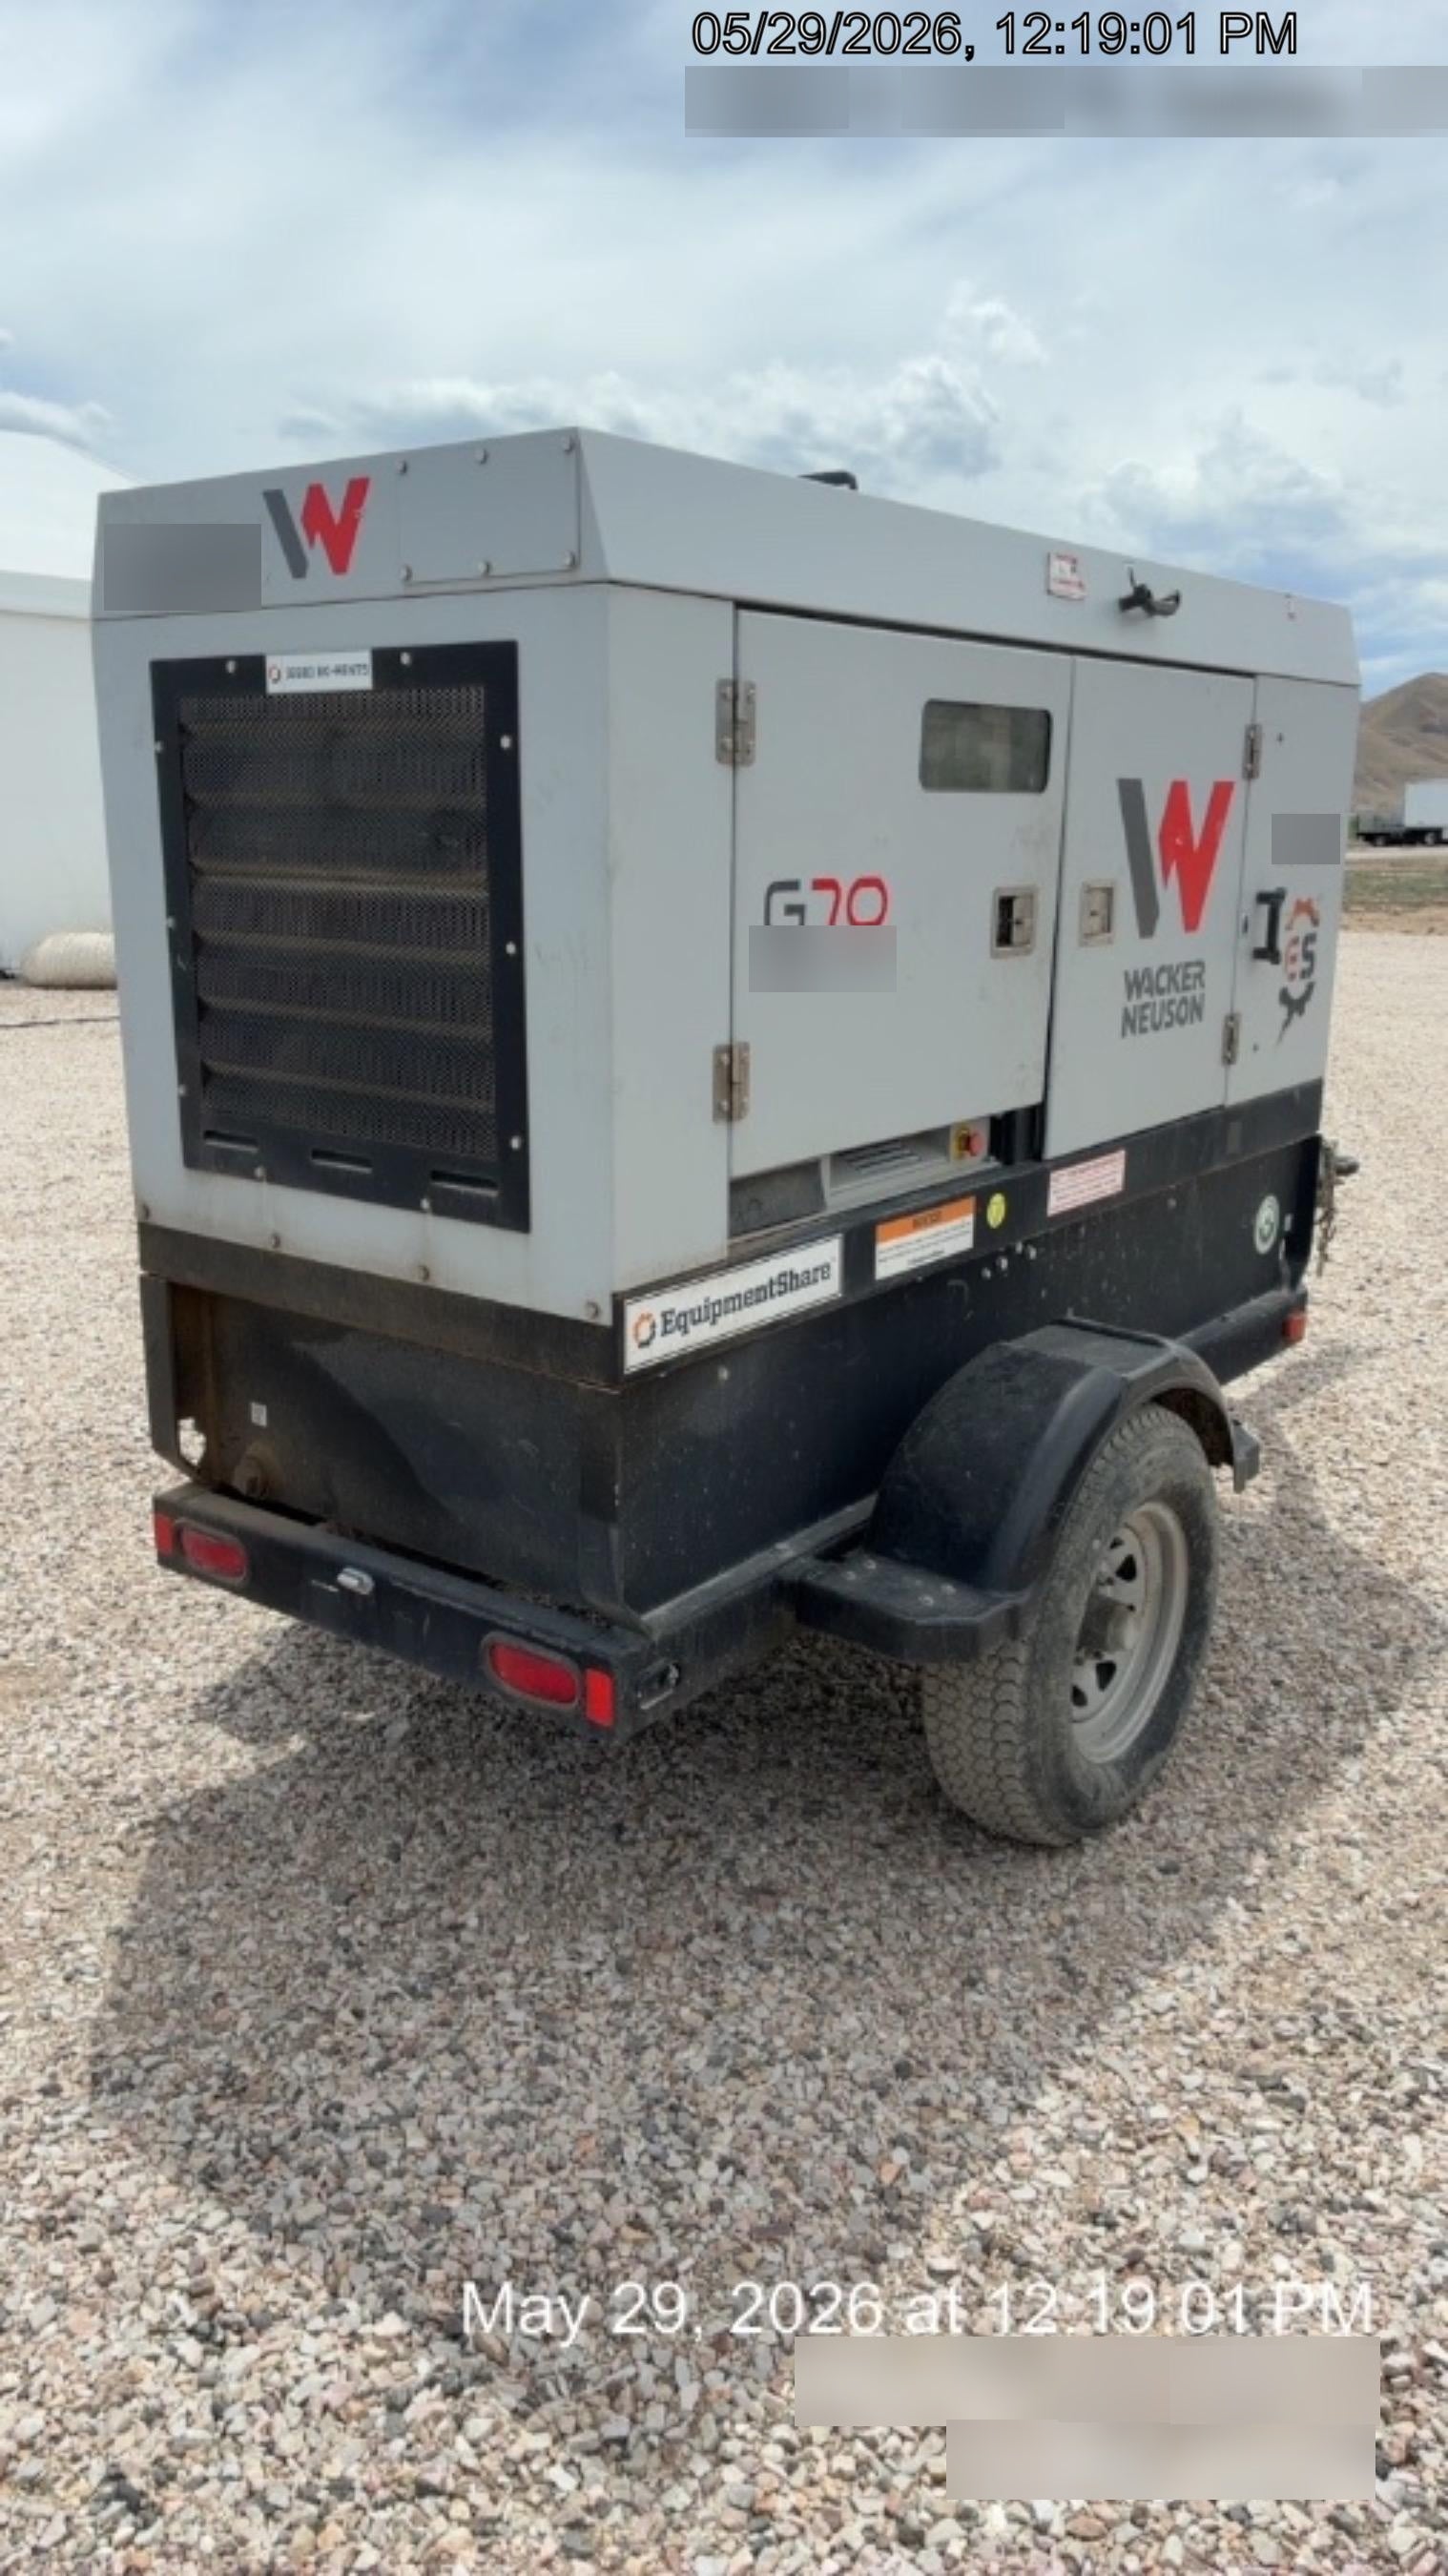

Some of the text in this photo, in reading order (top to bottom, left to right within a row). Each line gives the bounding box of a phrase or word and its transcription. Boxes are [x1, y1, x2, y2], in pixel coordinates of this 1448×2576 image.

[763, 876, 889, 926] G70
[1124, 959, 1206, 1003] WACKER
[1121, 992, 1206, 1039] NEUSON
[660, 1261, 832, 1337] EquipmentShare
